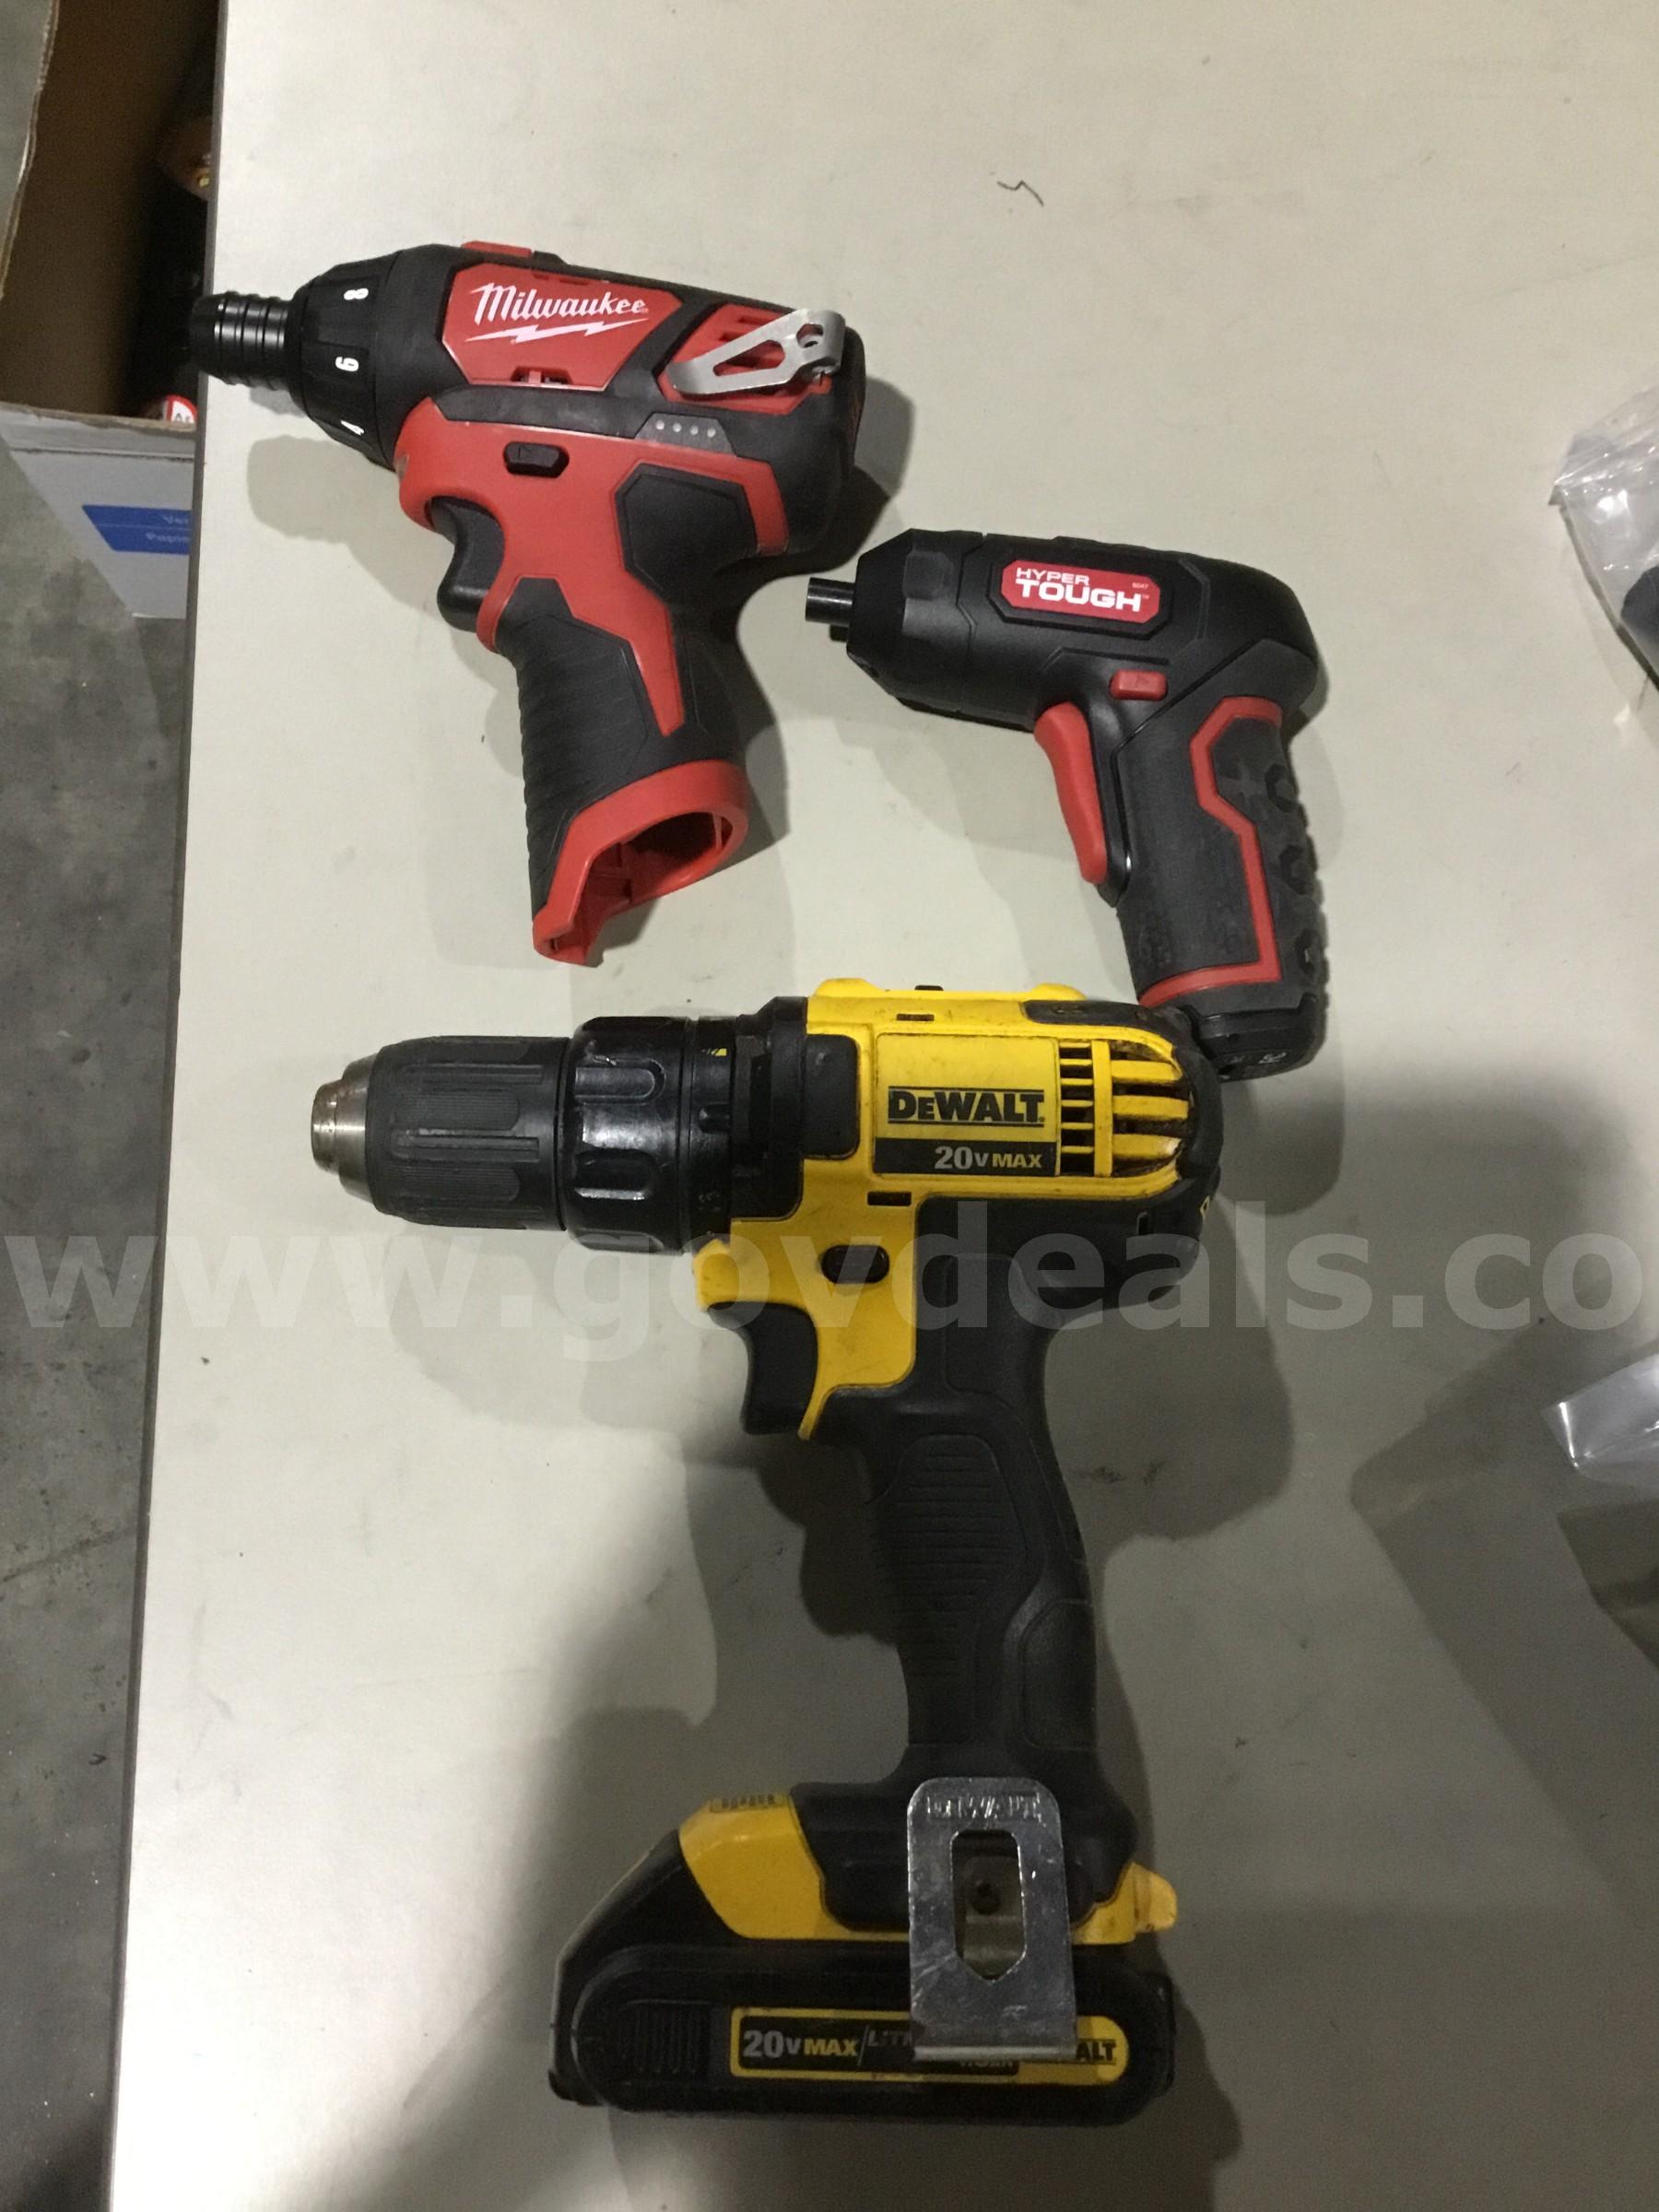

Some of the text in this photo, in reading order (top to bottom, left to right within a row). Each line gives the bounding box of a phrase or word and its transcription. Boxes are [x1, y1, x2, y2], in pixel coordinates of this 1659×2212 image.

[469, 281, 648, 326] Milwaukee
[1016, 567, 1090, 586] HYPER
[1015, 577, 1142, 612] TOUGH
[992, 1153, 1042, 1169] MAX
[804, 2038, 860, 2057] MAX
